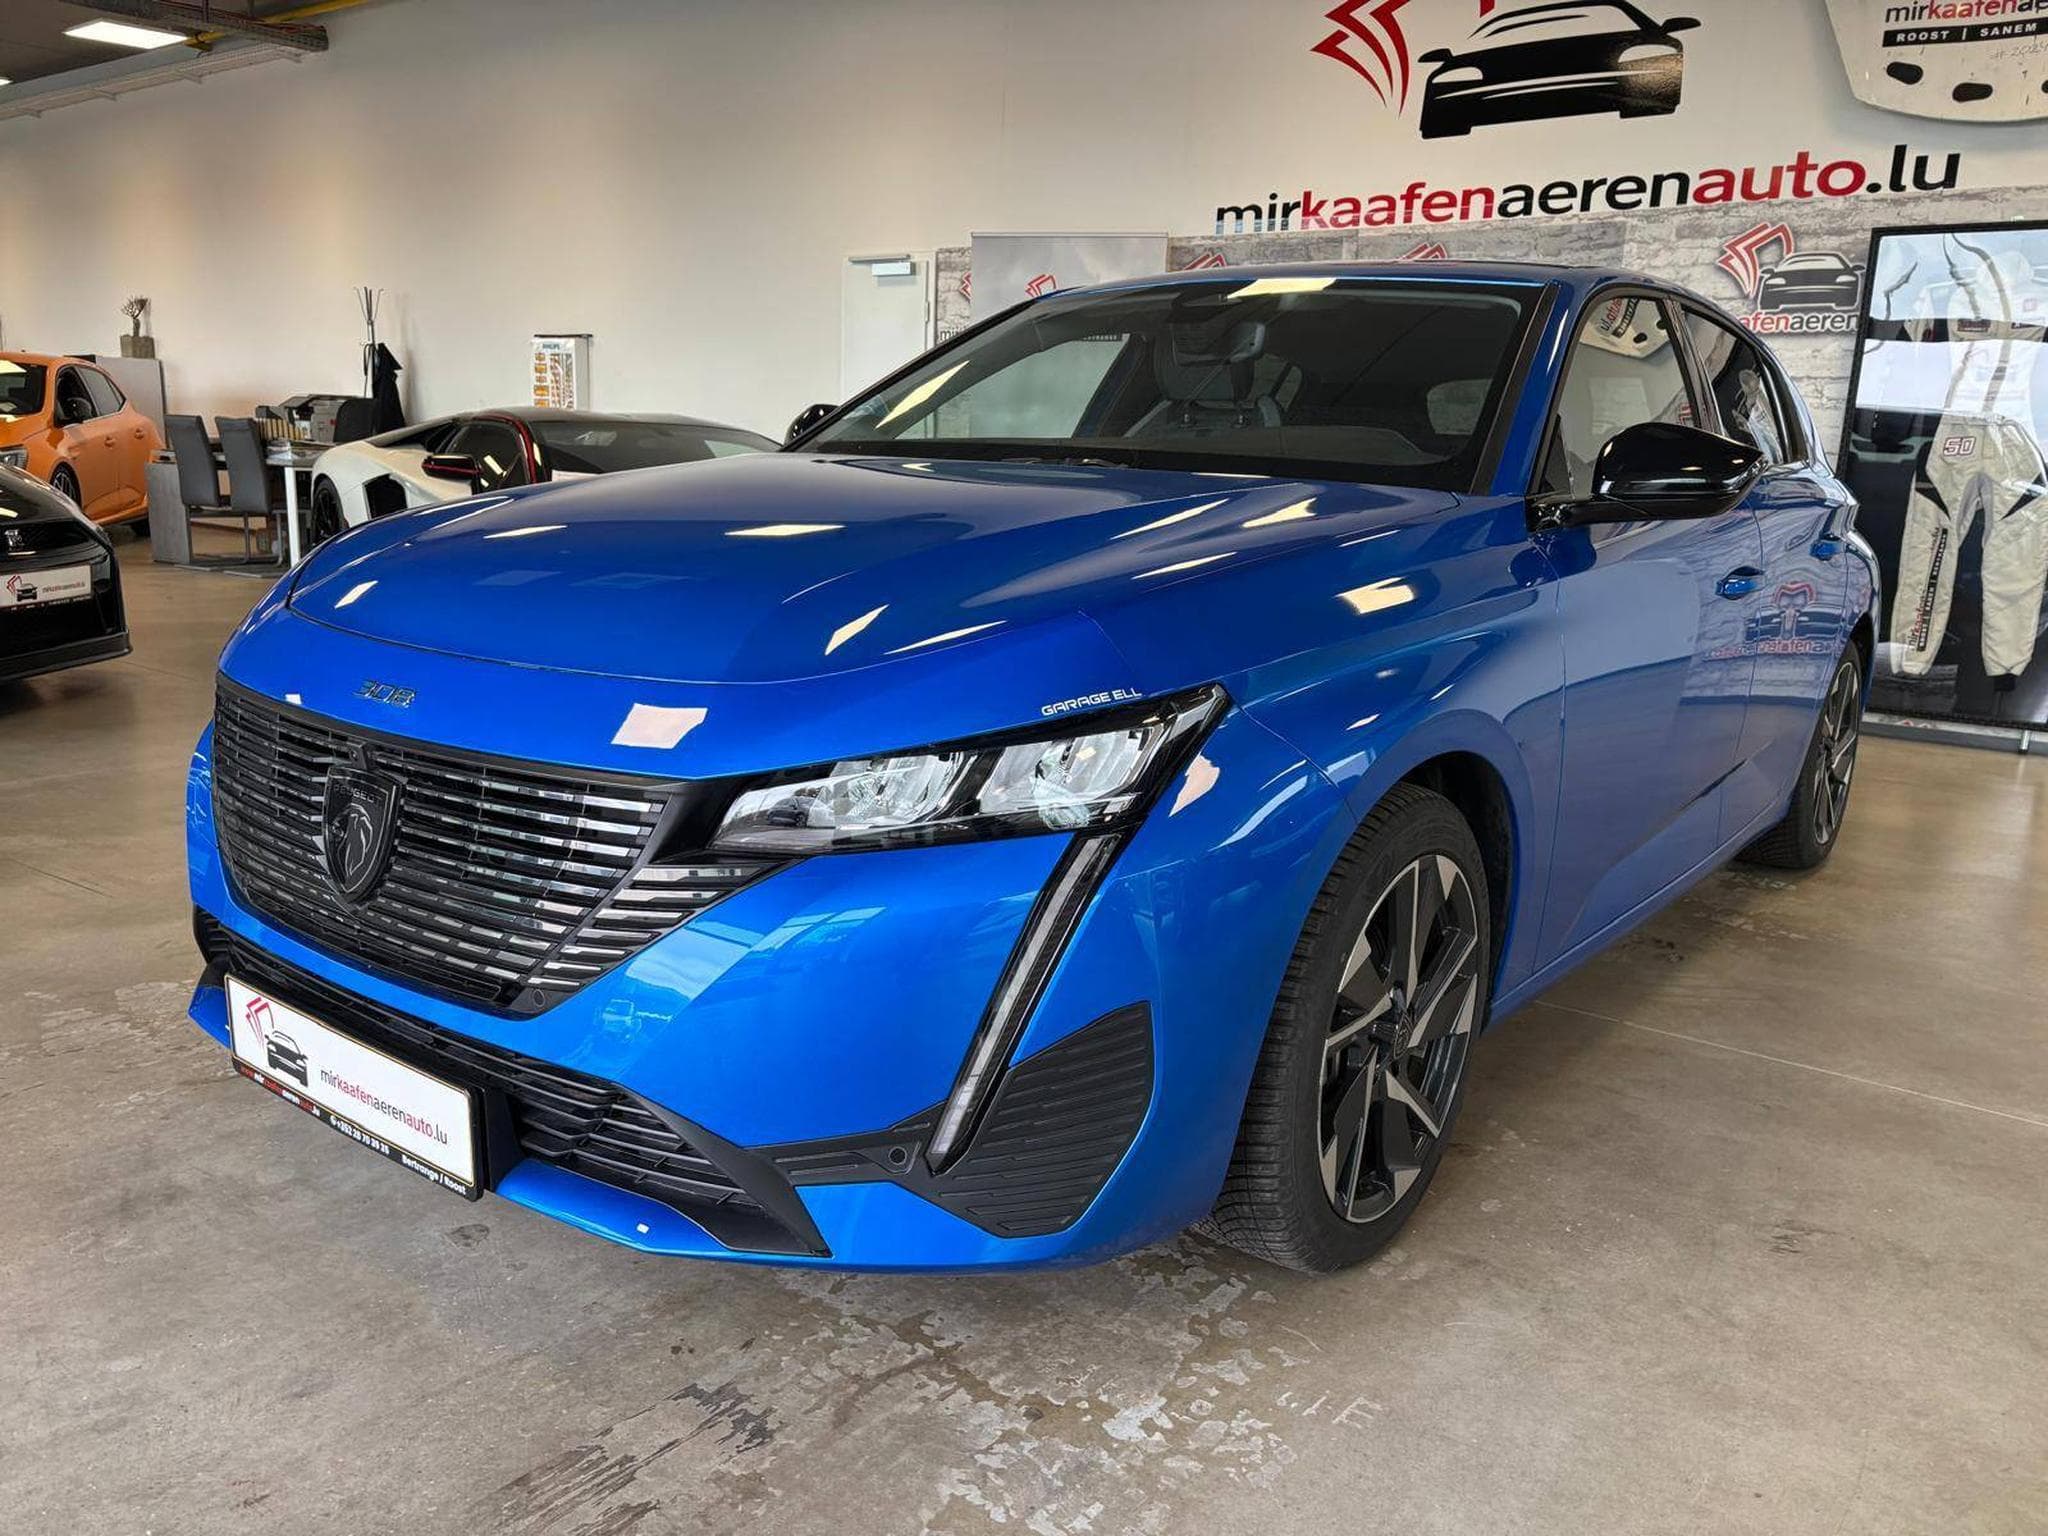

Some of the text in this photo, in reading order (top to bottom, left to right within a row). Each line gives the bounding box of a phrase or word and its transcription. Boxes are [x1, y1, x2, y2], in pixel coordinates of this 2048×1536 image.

[1896, 30, 1949, 42] ROOST
[1980, 23, 2037, 37] SANEM
[1215, 144, 1961, 236] mirkaafenaerenauto.lu
[1943, 436, 1976, 456] 50
[352, 679, 416, 708] 308
[1041, 687, 1142, 715] GARAGE ELL
[320, 1069, 448, 1145] mirkaafenaerenauto.lu
